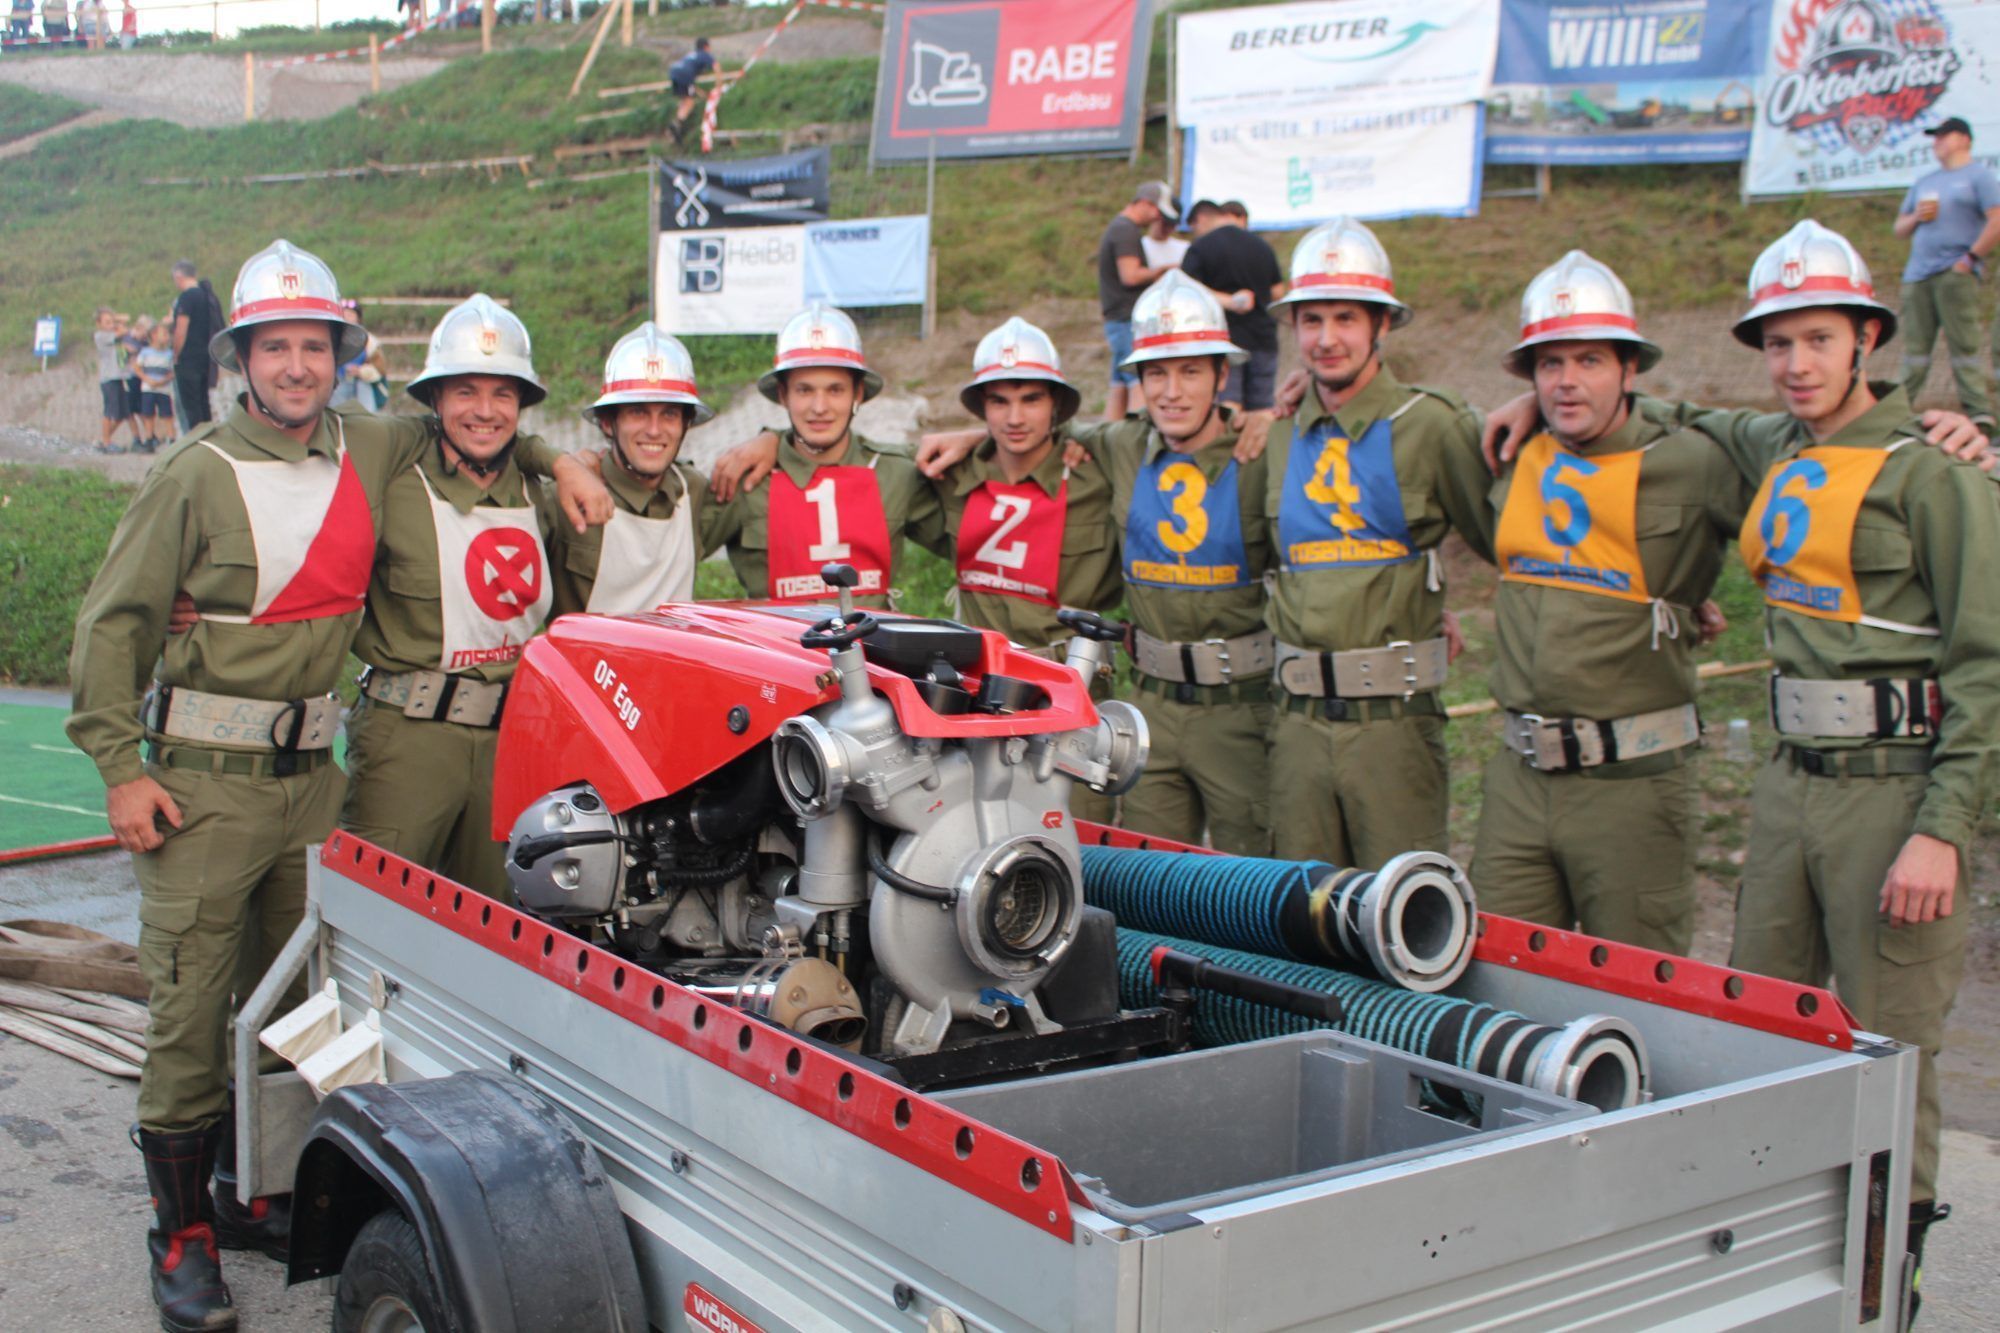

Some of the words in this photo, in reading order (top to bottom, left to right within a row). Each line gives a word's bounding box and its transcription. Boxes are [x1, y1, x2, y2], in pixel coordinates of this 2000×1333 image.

[1008, 41, 1118, 85] RABE
[1229, 17, 1389, 50] BEREUTER
[1548, 16, 1658, 69] Willi
[1041, 92, 1112, 114] Erdbau
[727, 236, 797, 266] HeiBa
[805, 478, 851, 562] 1
[1157, 462, 1209, 553] 3
[1304, 437, 1367, 530] 4
[1540, 452, 1600, 547] 5
[1760, 458, 1828, 566] 6
[975, 494, 1032, 569] 2
[593, 660, 617, 690] OF
[613, 682, 641, 731] Egg
